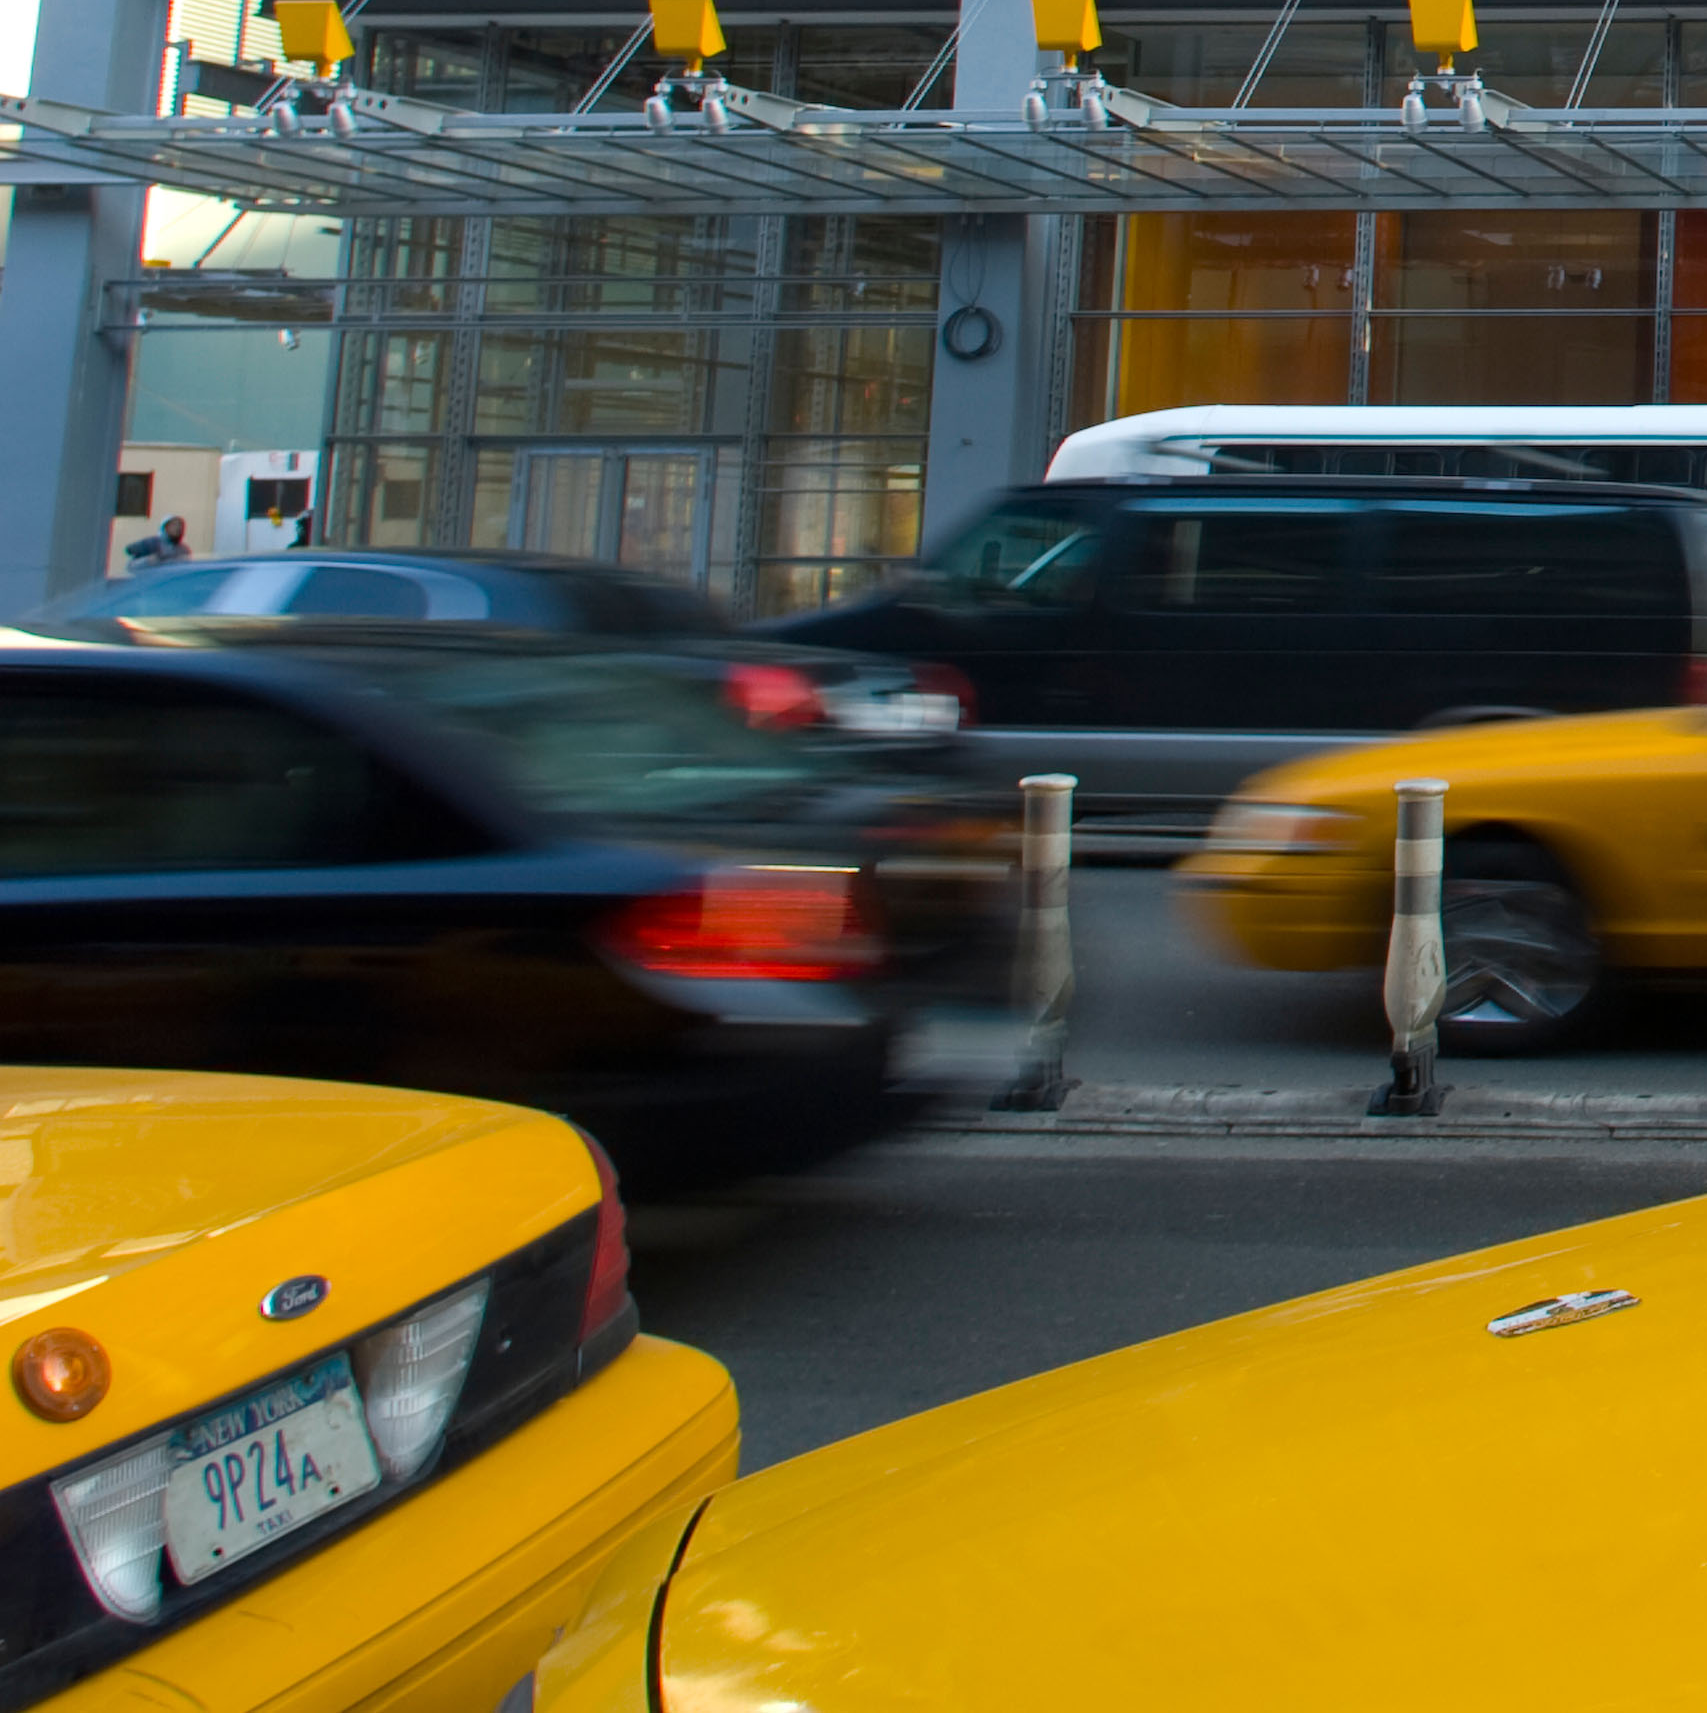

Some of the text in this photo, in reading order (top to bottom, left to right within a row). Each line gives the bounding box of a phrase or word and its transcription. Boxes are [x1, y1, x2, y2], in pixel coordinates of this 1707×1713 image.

[281, 1282, 318, 1311] Ford
[197, 1387, 306, 1451] NEW YORK
[257, 1510, 295, 1535] TAXI
